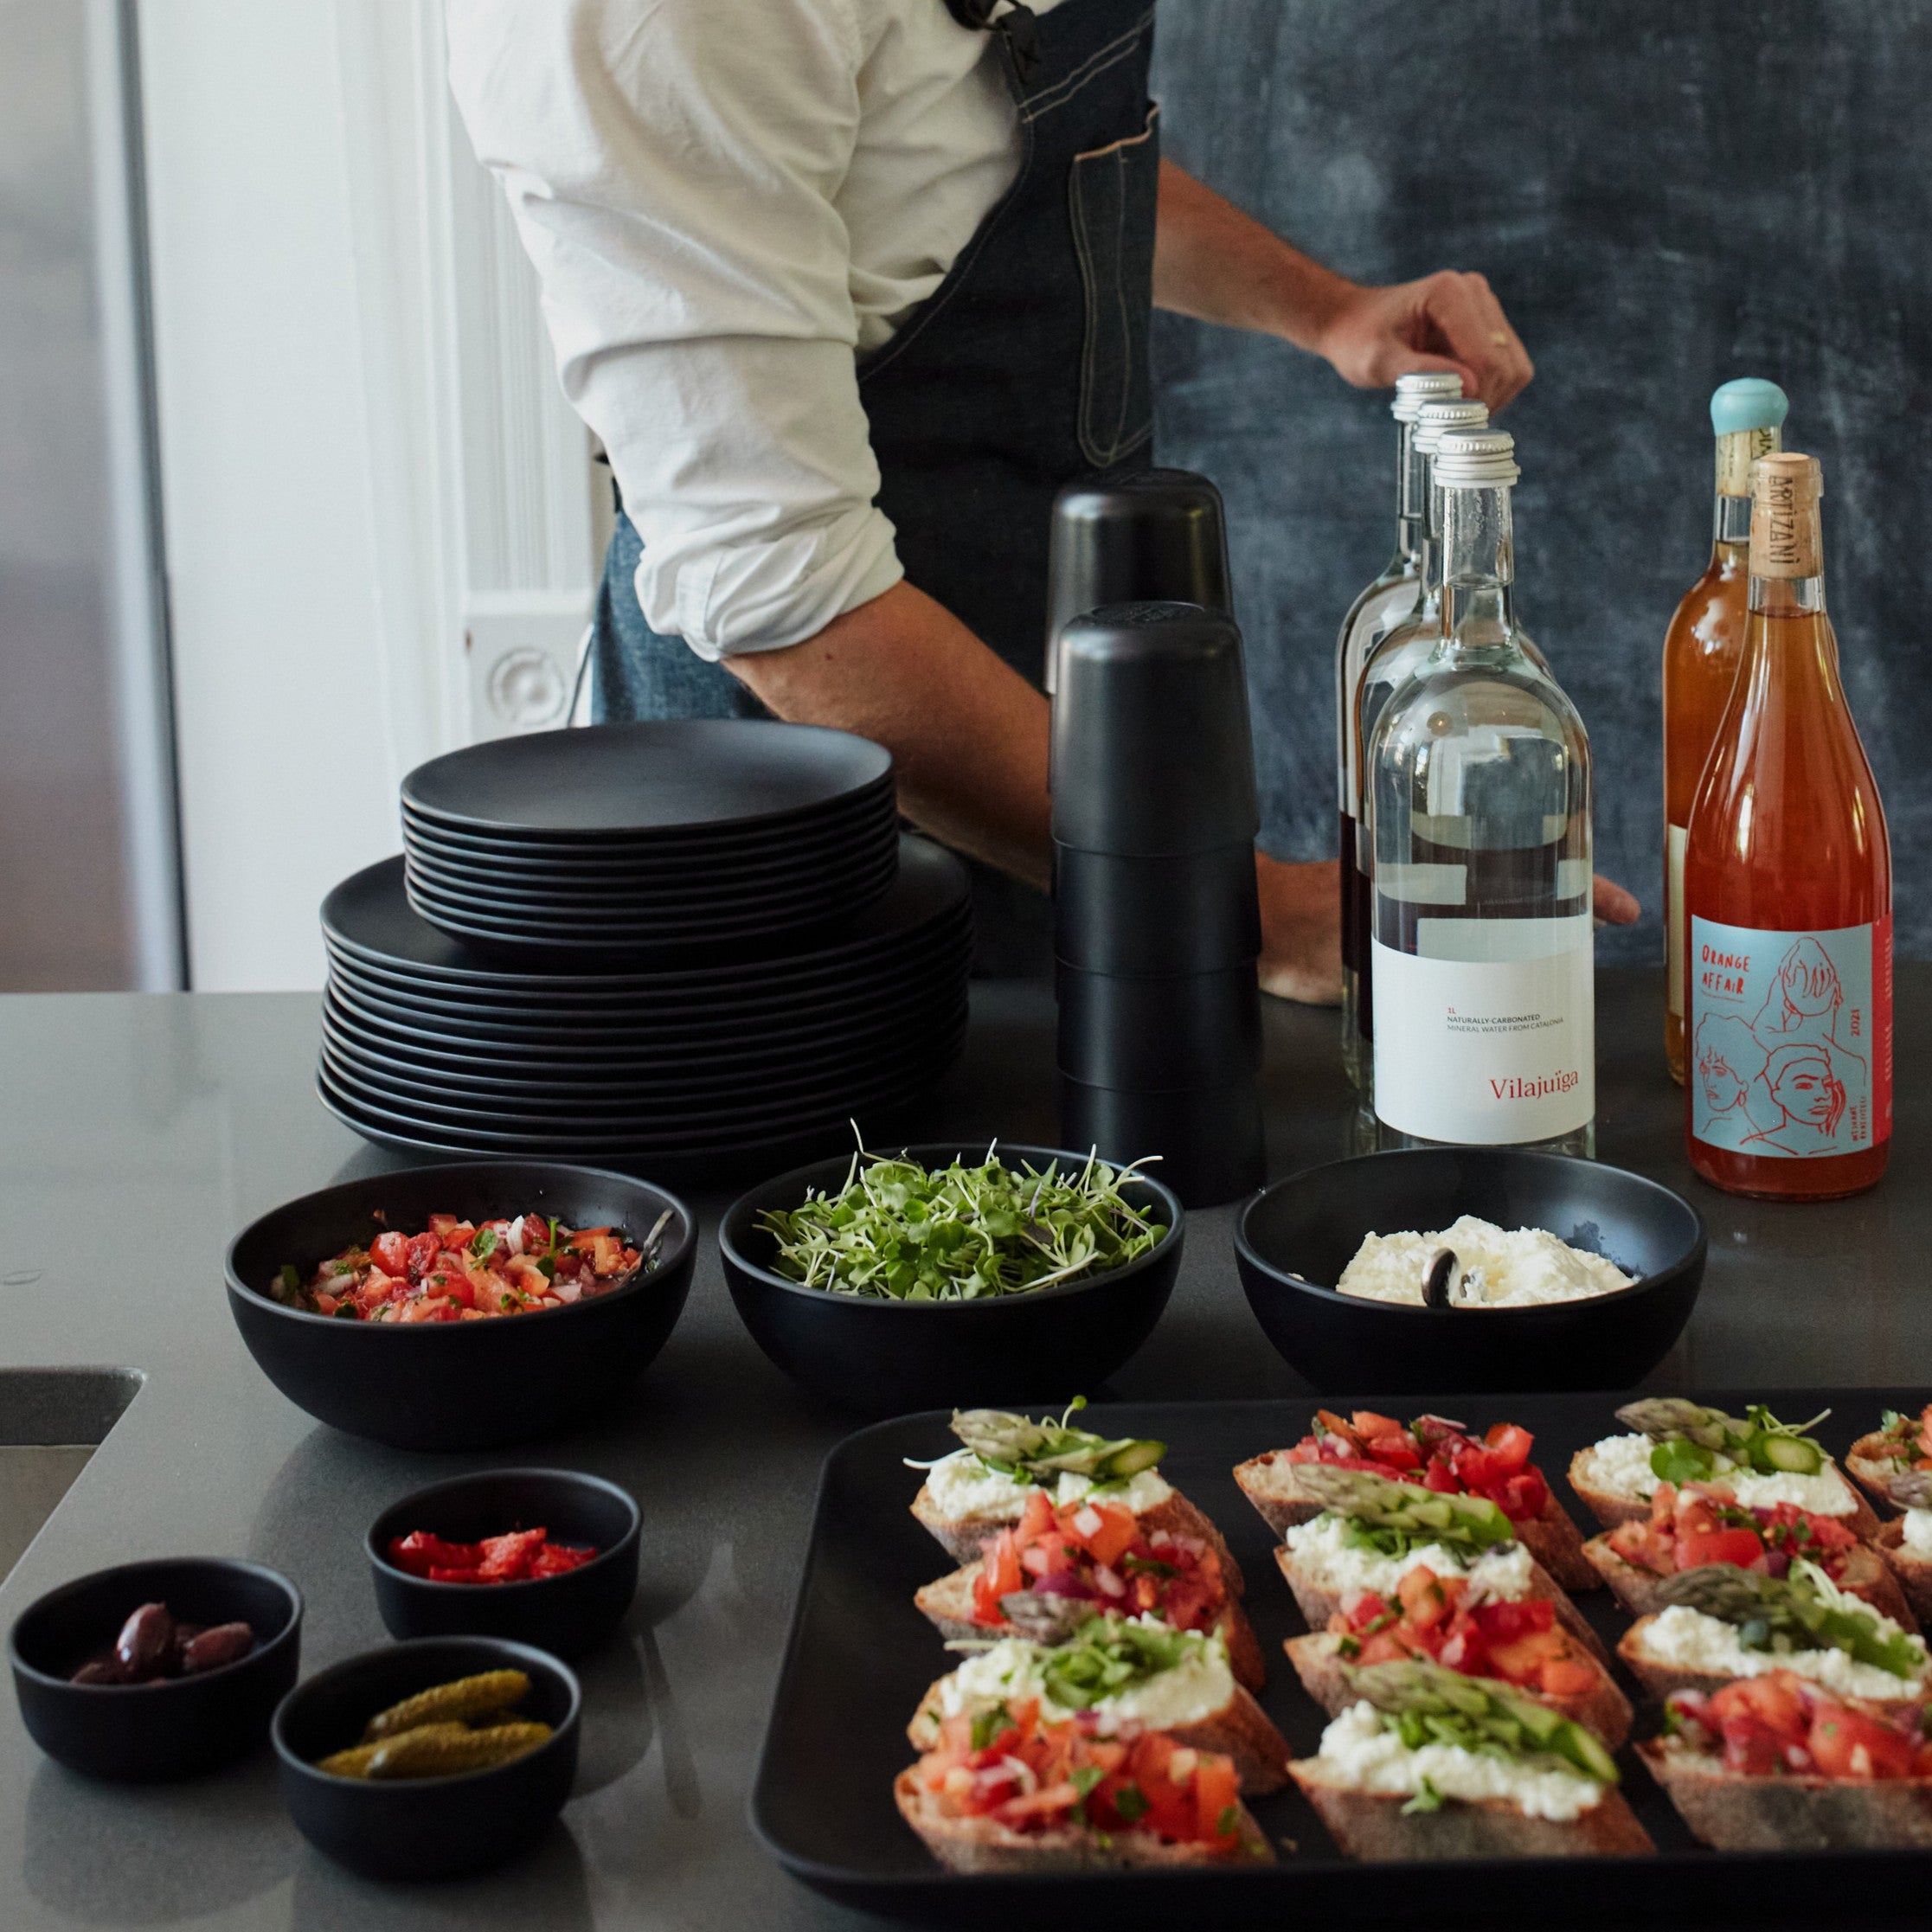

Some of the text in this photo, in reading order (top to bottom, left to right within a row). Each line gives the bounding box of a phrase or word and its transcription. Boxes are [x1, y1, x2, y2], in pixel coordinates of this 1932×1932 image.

[1702, 944, 1751, 973] ORANGE
[1447, 1014, 1541, 1024] NATURALLY-CARBONATED
[1530, 1017, 1564, 1030] CATALONIA
[1851, 1009, 1860, 1037] 2021
[1489, 1069, 1578, 1100] Vilajuïga
